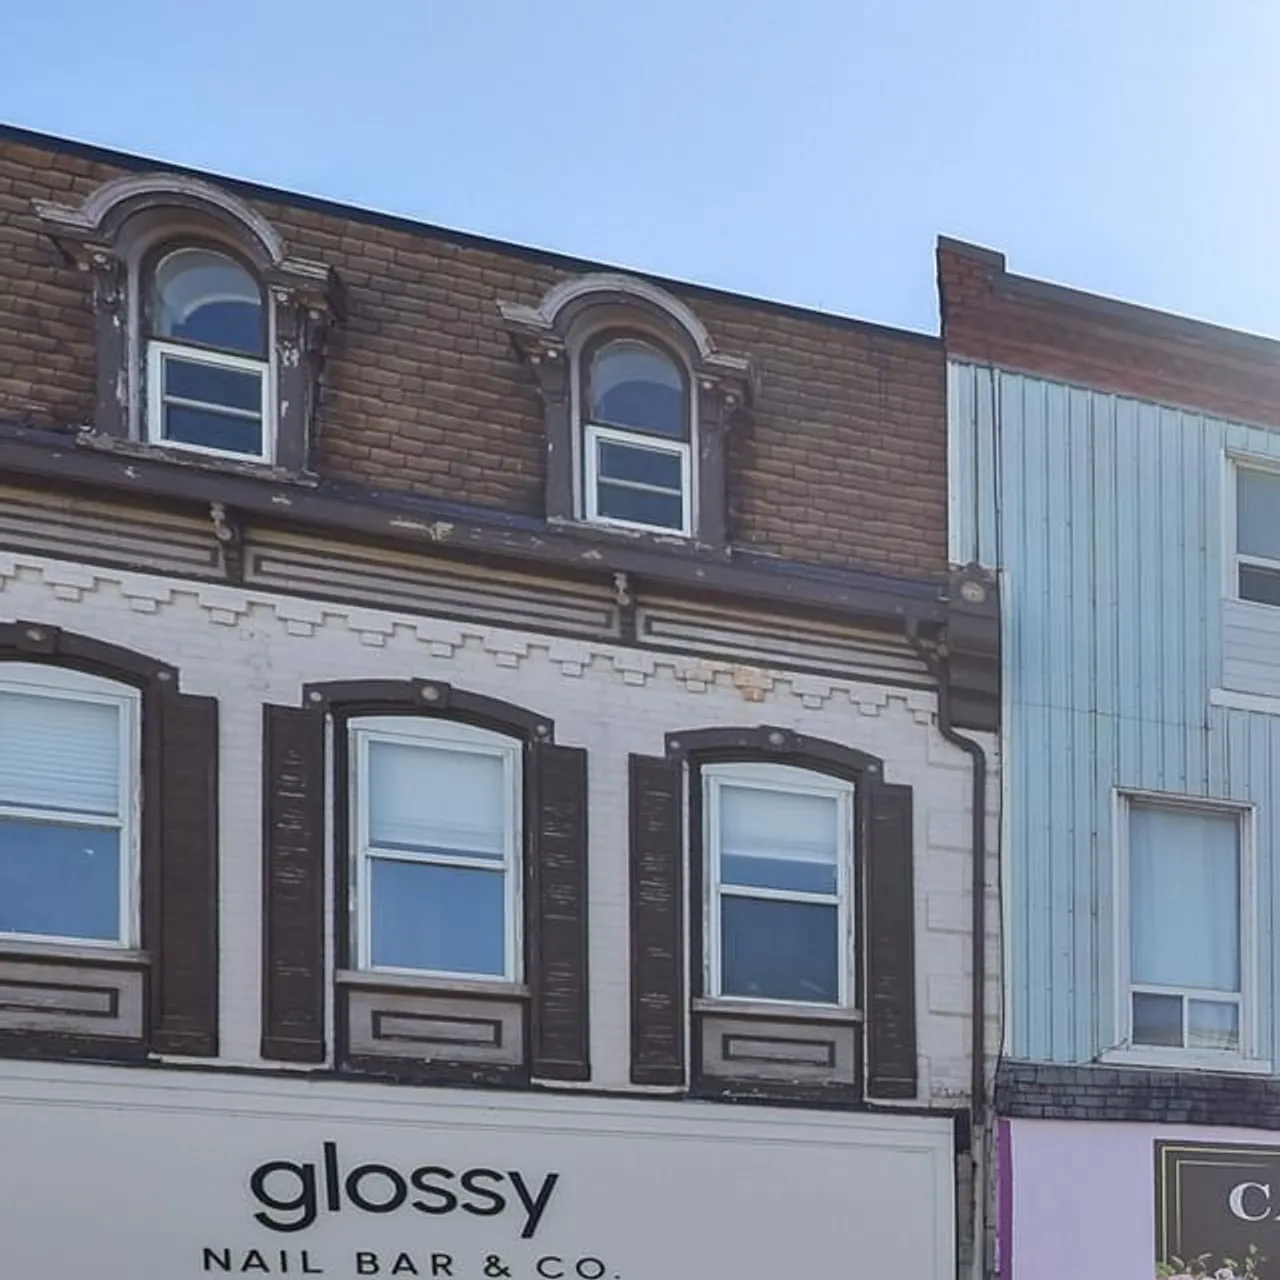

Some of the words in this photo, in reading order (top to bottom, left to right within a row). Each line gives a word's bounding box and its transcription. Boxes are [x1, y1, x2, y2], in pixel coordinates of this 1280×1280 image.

[250, 1141, 559, 1239] glossy
[203, 1247, 324, 1274] NAIL
[356, 1251, 453, 1276] BAR
[483, 1254, 512, 1278] &
[536, 1255, 621, 1280] CO.
